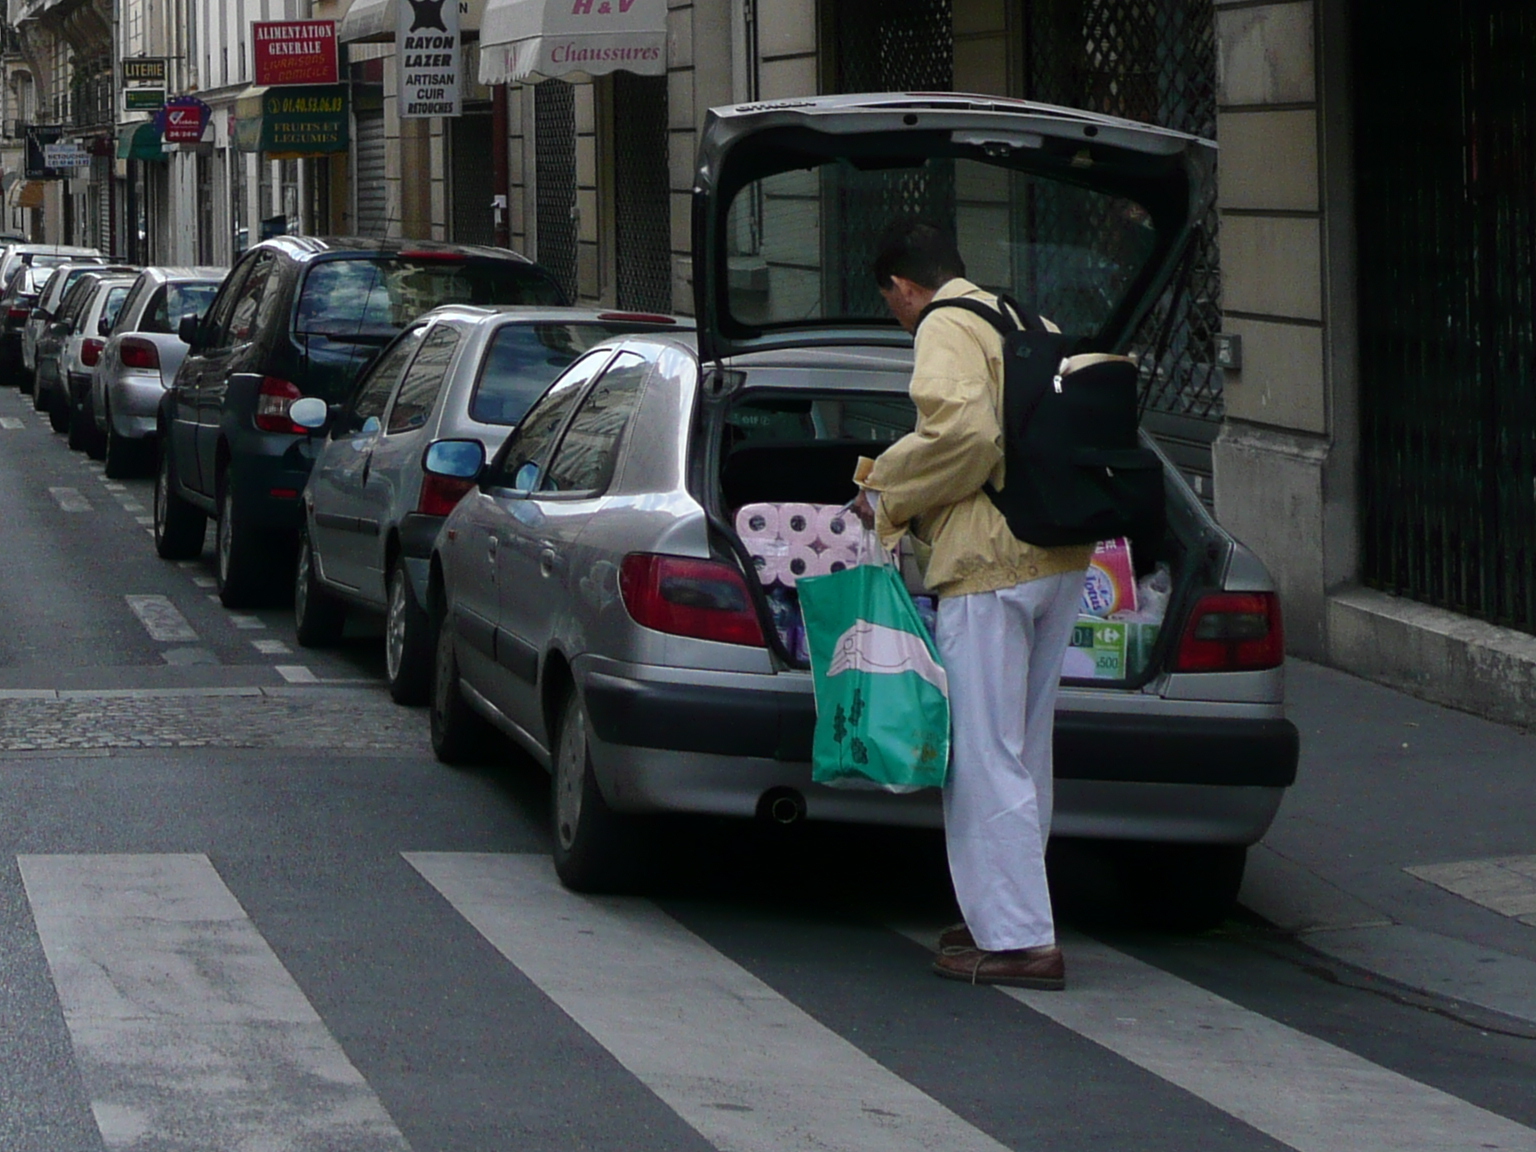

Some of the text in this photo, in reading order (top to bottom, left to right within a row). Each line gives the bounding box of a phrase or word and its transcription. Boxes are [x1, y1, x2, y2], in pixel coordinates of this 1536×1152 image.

[597, 1, 613, 14] &
[257, 24, 332, 41] ALIMENTATION
[269, 41, 322, 56] GENERALE
[405, 36, 455, 50] RAYON
[551, 41, 660, 64] Chaussures
[405, 54, 452, 68] LAZER
[125, 63, 163, 77] LITERIE
[406, 74, 455, 86] ARTISAN
[417, 88, 445, 99] CUIR
[408, 102, 453, 115] RETOUCHES
[275, 121, 340, 132] FRUITS ET
[274, 133, 338, 143] LEGUMES
